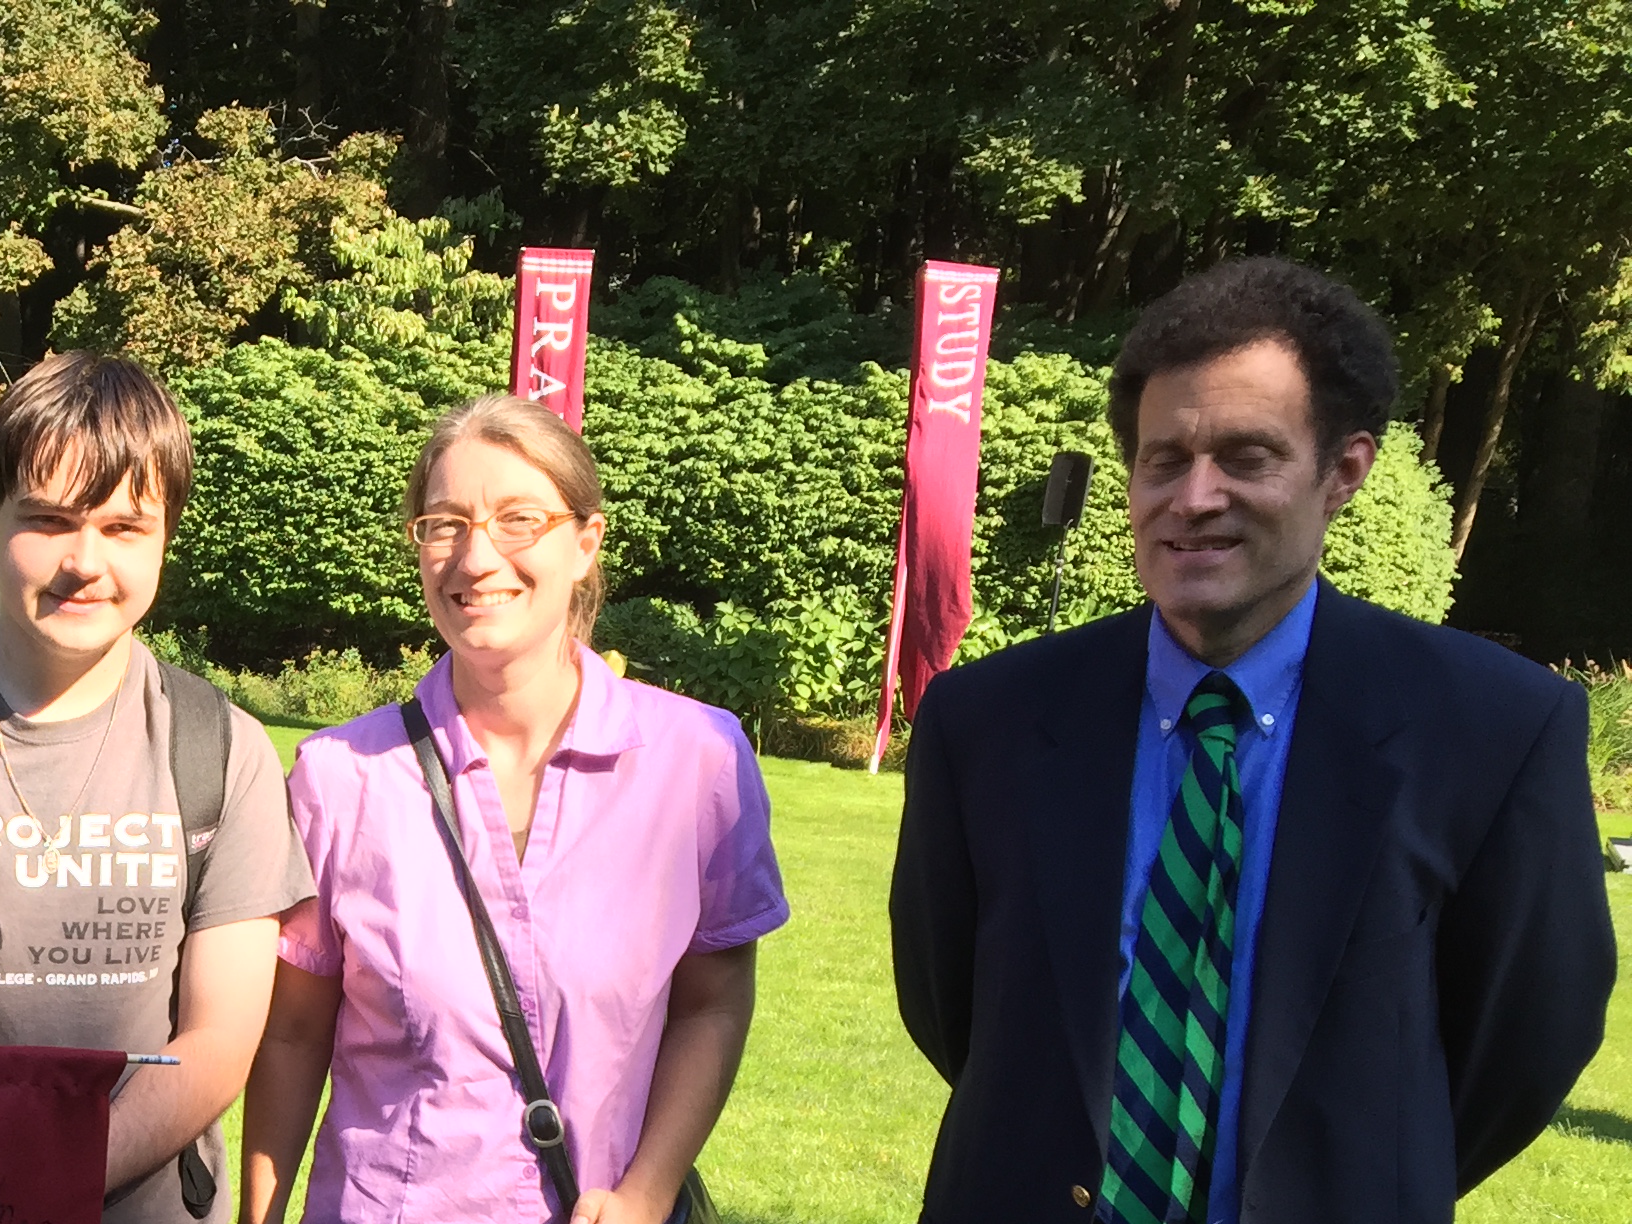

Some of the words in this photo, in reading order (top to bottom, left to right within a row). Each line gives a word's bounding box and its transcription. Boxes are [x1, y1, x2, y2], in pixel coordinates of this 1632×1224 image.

[928, 283, 982, 425] STUDY
[15, 852, 179, 888] UNITE
[97, 896, 171, 915] LOVE
[61, 921, 166, 940] WHERE
[27, 945, 92, 965] YOU
[104, 944, 162, 965] LIVE
[45, 972, 98, 986] GRAND
